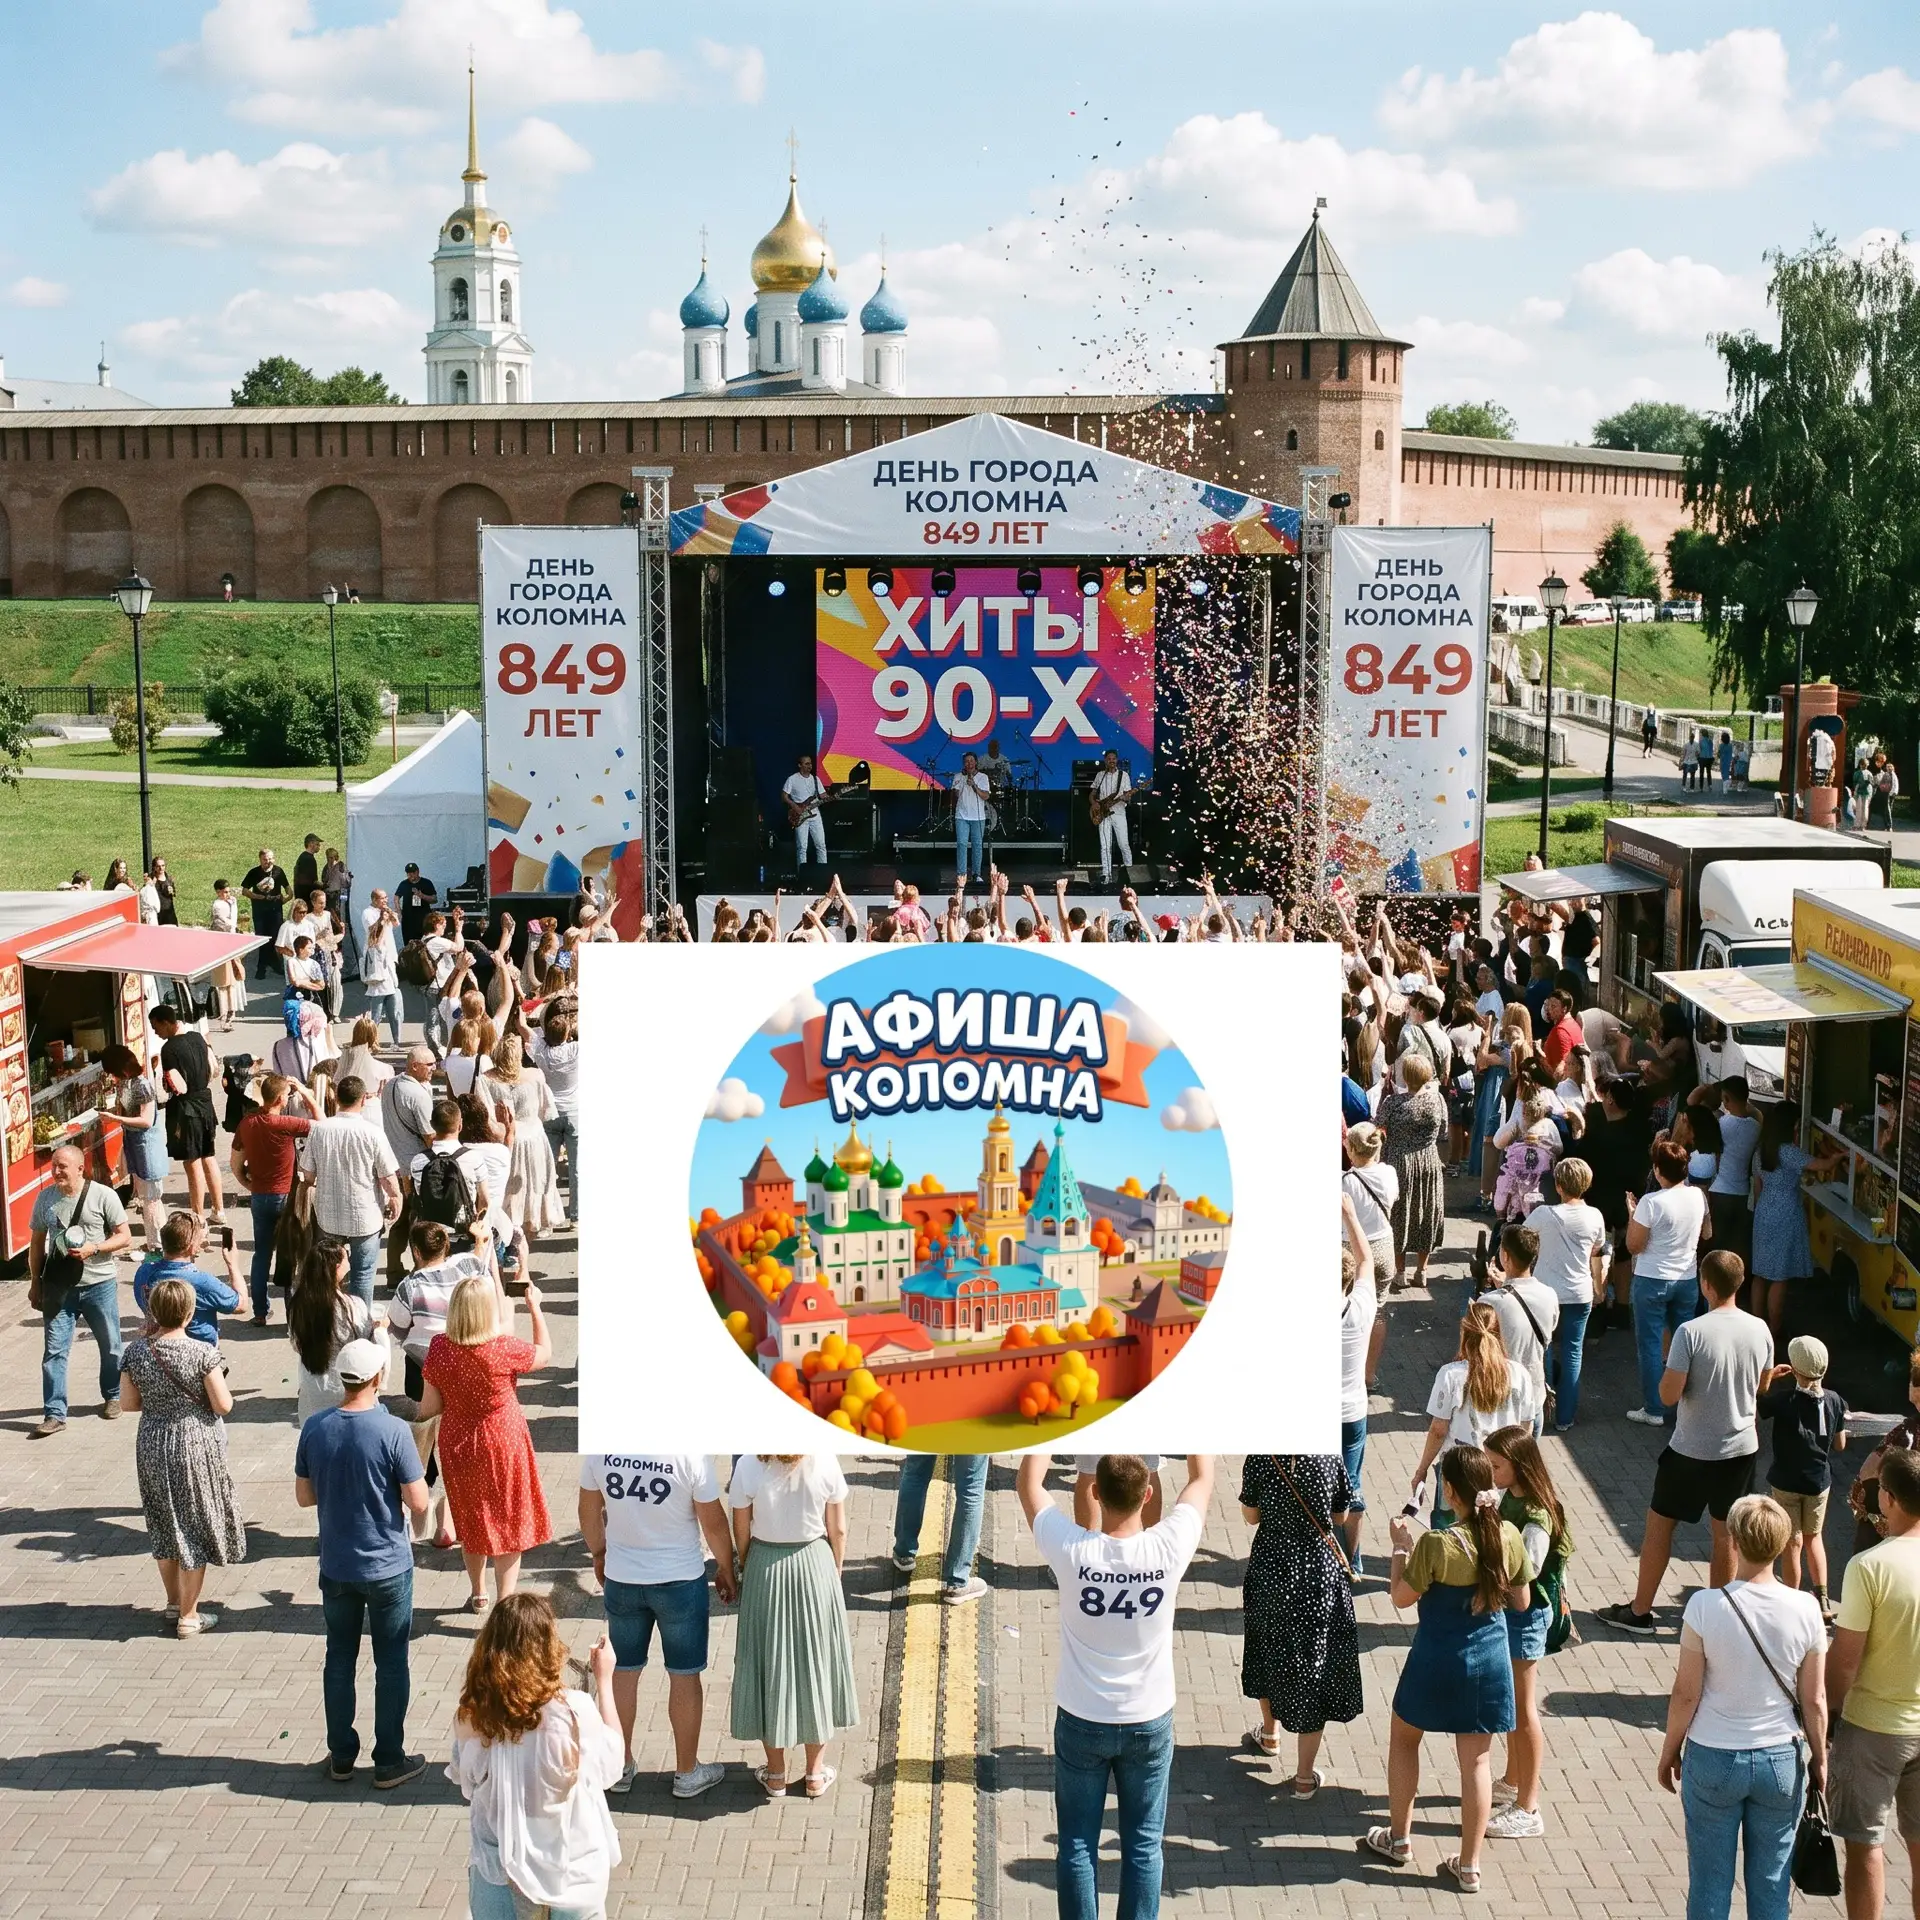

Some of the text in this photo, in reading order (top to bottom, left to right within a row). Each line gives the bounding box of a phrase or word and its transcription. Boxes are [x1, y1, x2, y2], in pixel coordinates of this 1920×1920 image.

[873, 460, 1099, 488] ДЕНЬ ГОРОДА
[905, 490, 1068, 513] КОЛОМНА
[923, 522, 1049, 545] 849 ЛЕТ
[526, 558, 595, 580] ДЕНЬ
[1374, 558, 1444, 580] ДЕНЬ
[509, 583, 613, 604] ГОРОДА
[1357, 583, 1461, 604] ГОРОДА
[496, 607, 627, 626] КОЛОМНА
[872, 596, 1099, 652] ХИТЫ
[1344, 607, 1474, 627] КОЛОМНА
[497, 643, 627, 695] 849
[1344, 643, 1473, 695] 849
[872, 665, 1100, 739] 90-Х
[524, 709, 601, 738] ЛЕТ
[1368, 709, 1447, 738] ЛЕТ
[603, 1454, 674, 1475] Коломна
[605, 1472, 672, 1506] 849
[1078, 1566, 1165, 1584] Коломна
[1079, 1586, 1165, 1620] 849
